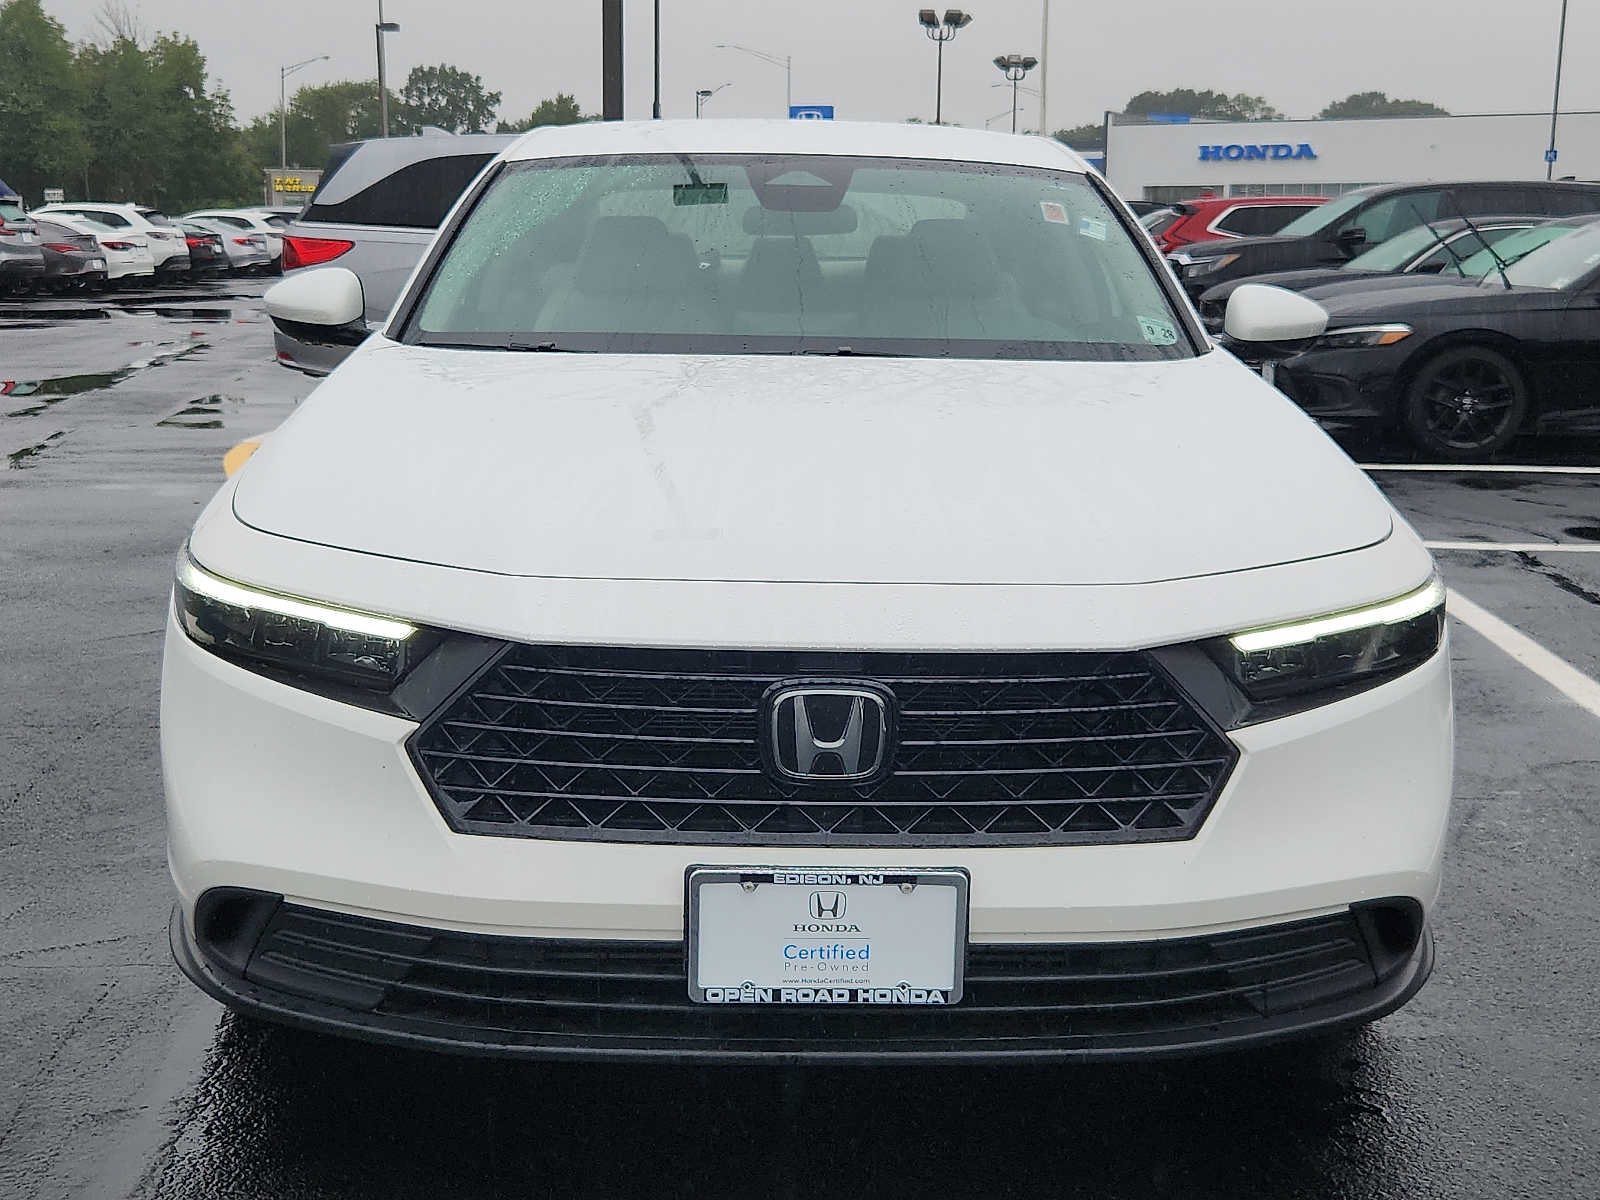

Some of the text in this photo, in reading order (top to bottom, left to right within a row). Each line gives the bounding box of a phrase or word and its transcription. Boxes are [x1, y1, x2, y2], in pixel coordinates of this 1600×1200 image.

[1198, 143, 1317, 161] HONDA
[773, 873, 884, 886] EDISON, NJ
[793, 923, 862, 933] HONDA
[783, 943, 871, 960] Certified
[784, 961, 869, 972] Pre-Owned
[705, 988, 946, 1005] OPEN ROAD HONDA
